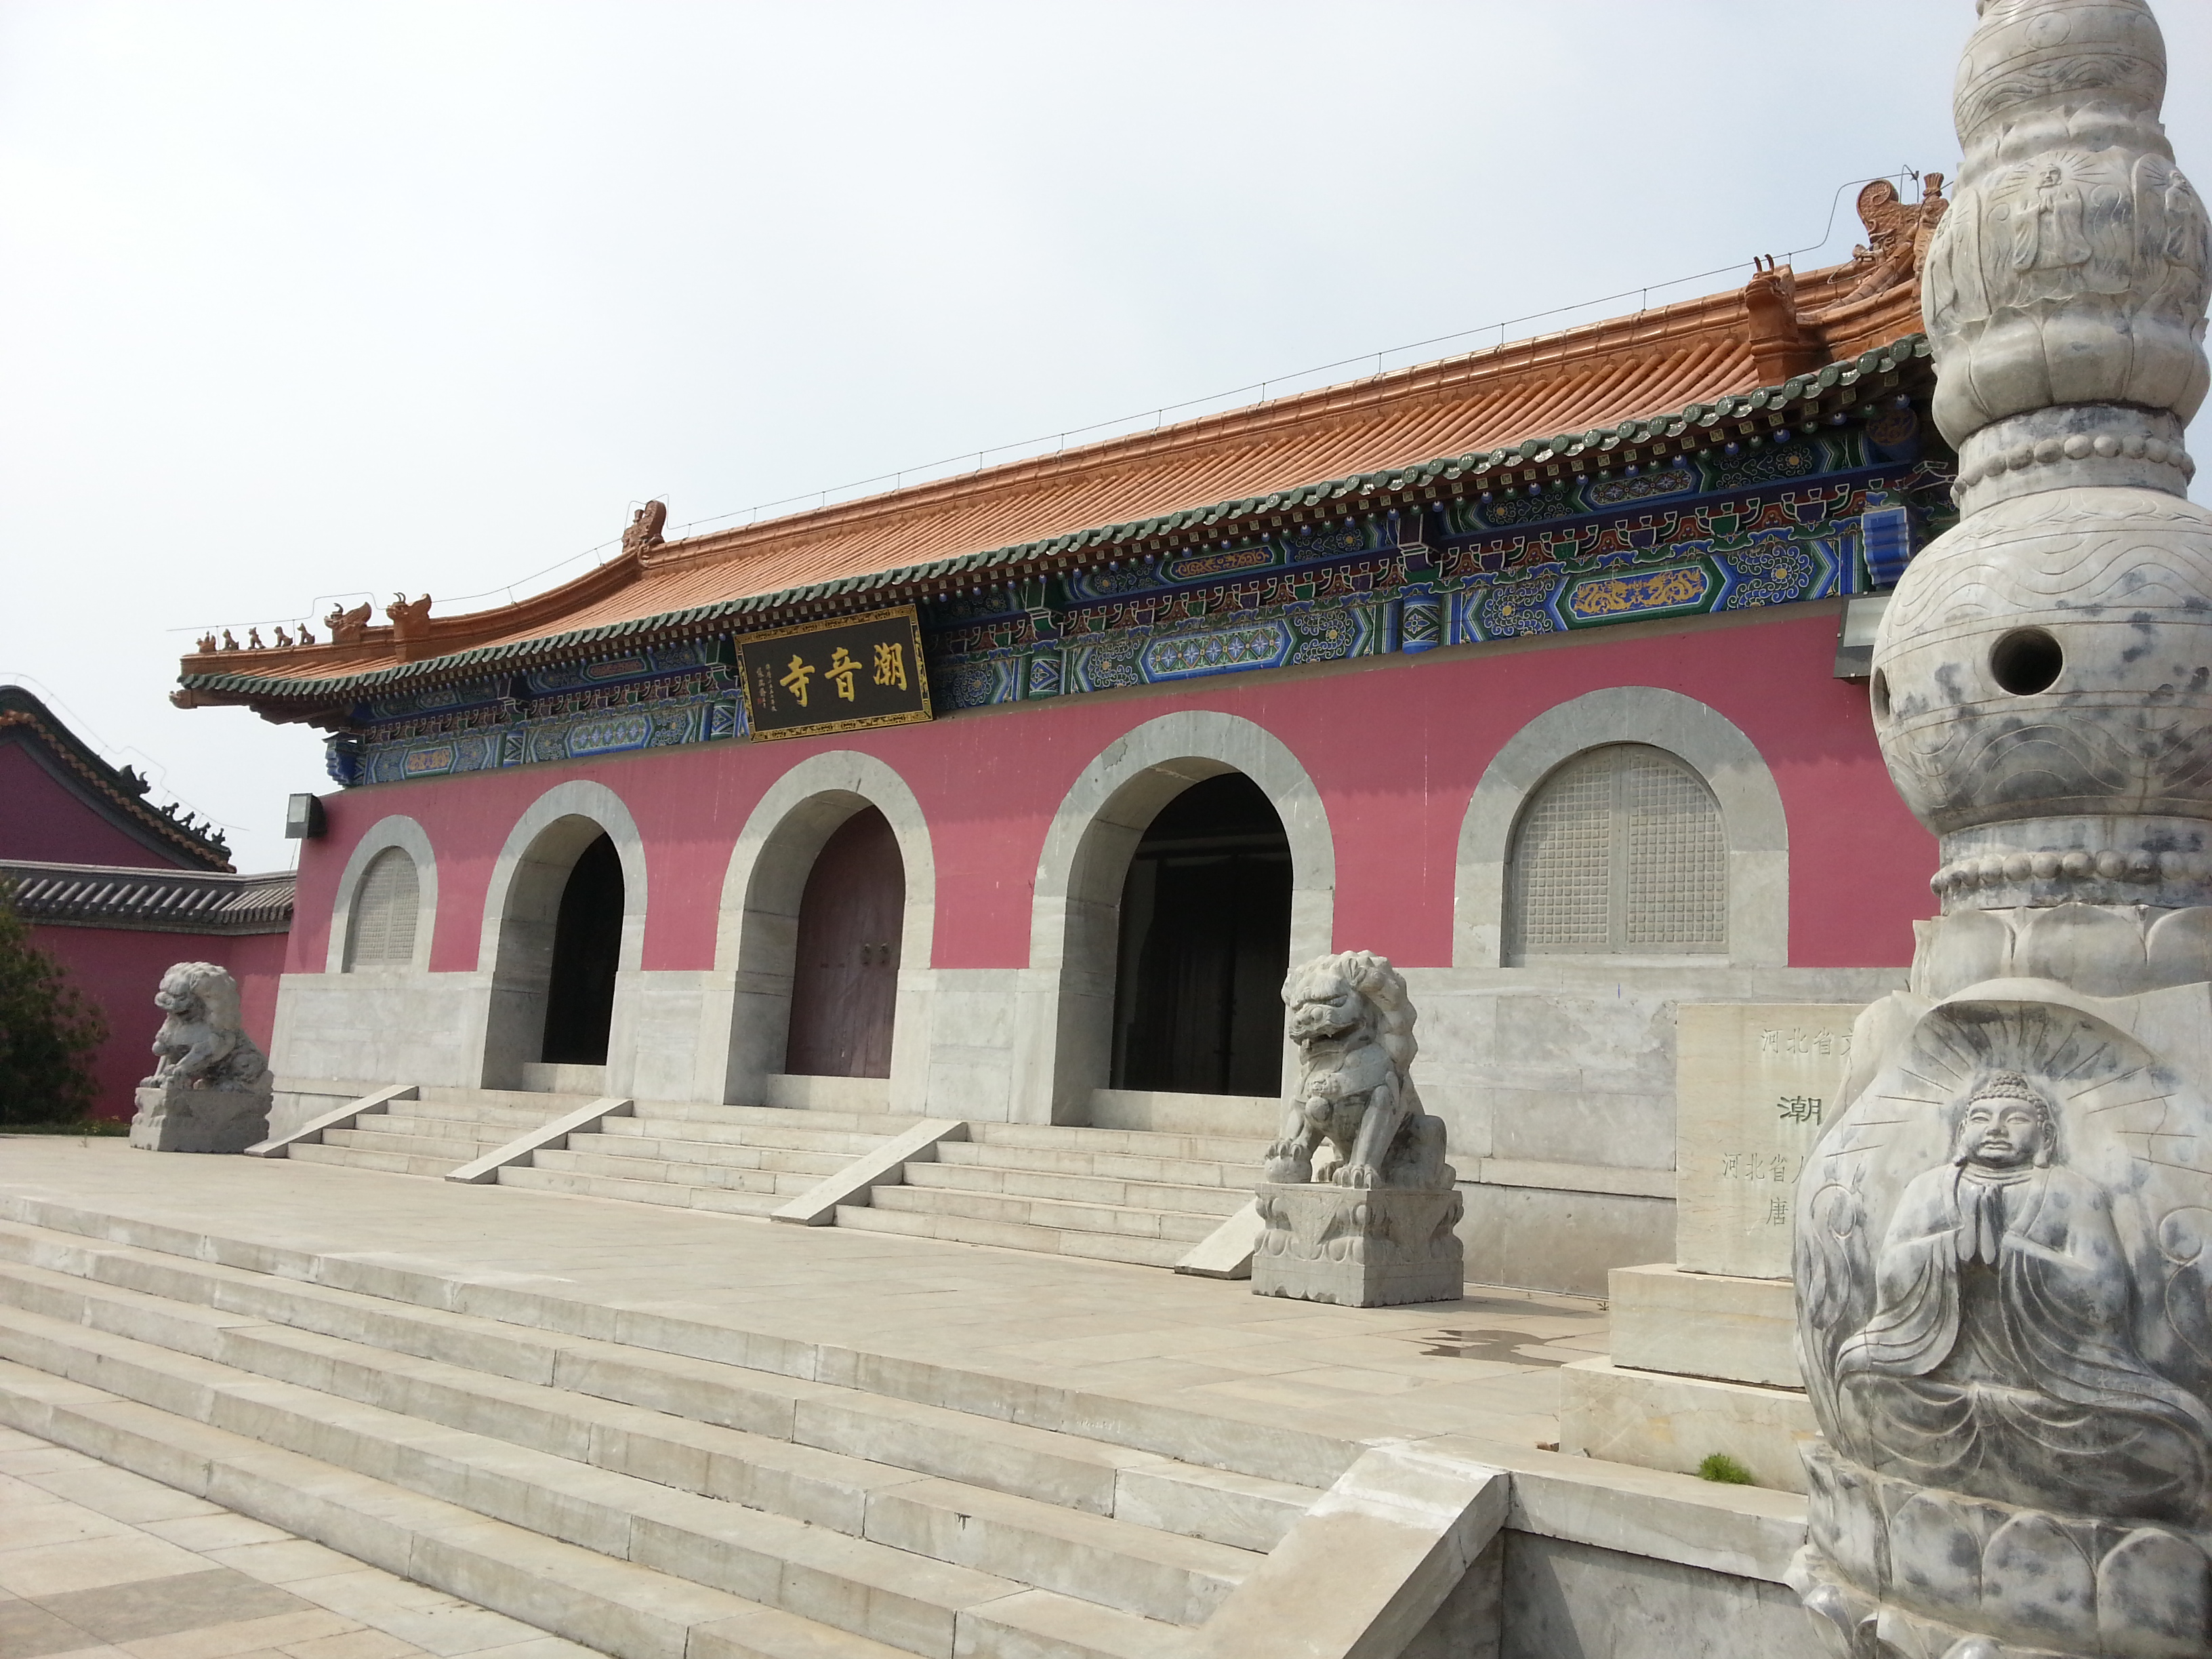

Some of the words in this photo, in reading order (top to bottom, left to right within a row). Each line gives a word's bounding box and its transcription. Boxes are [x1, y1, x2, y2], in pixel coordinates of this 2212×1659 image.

[779, 642, 907, 708] 潮音寺
[1777, 1095, 1822, 1126] 潮
[1766, 1197, 1789, 1227] 唐
